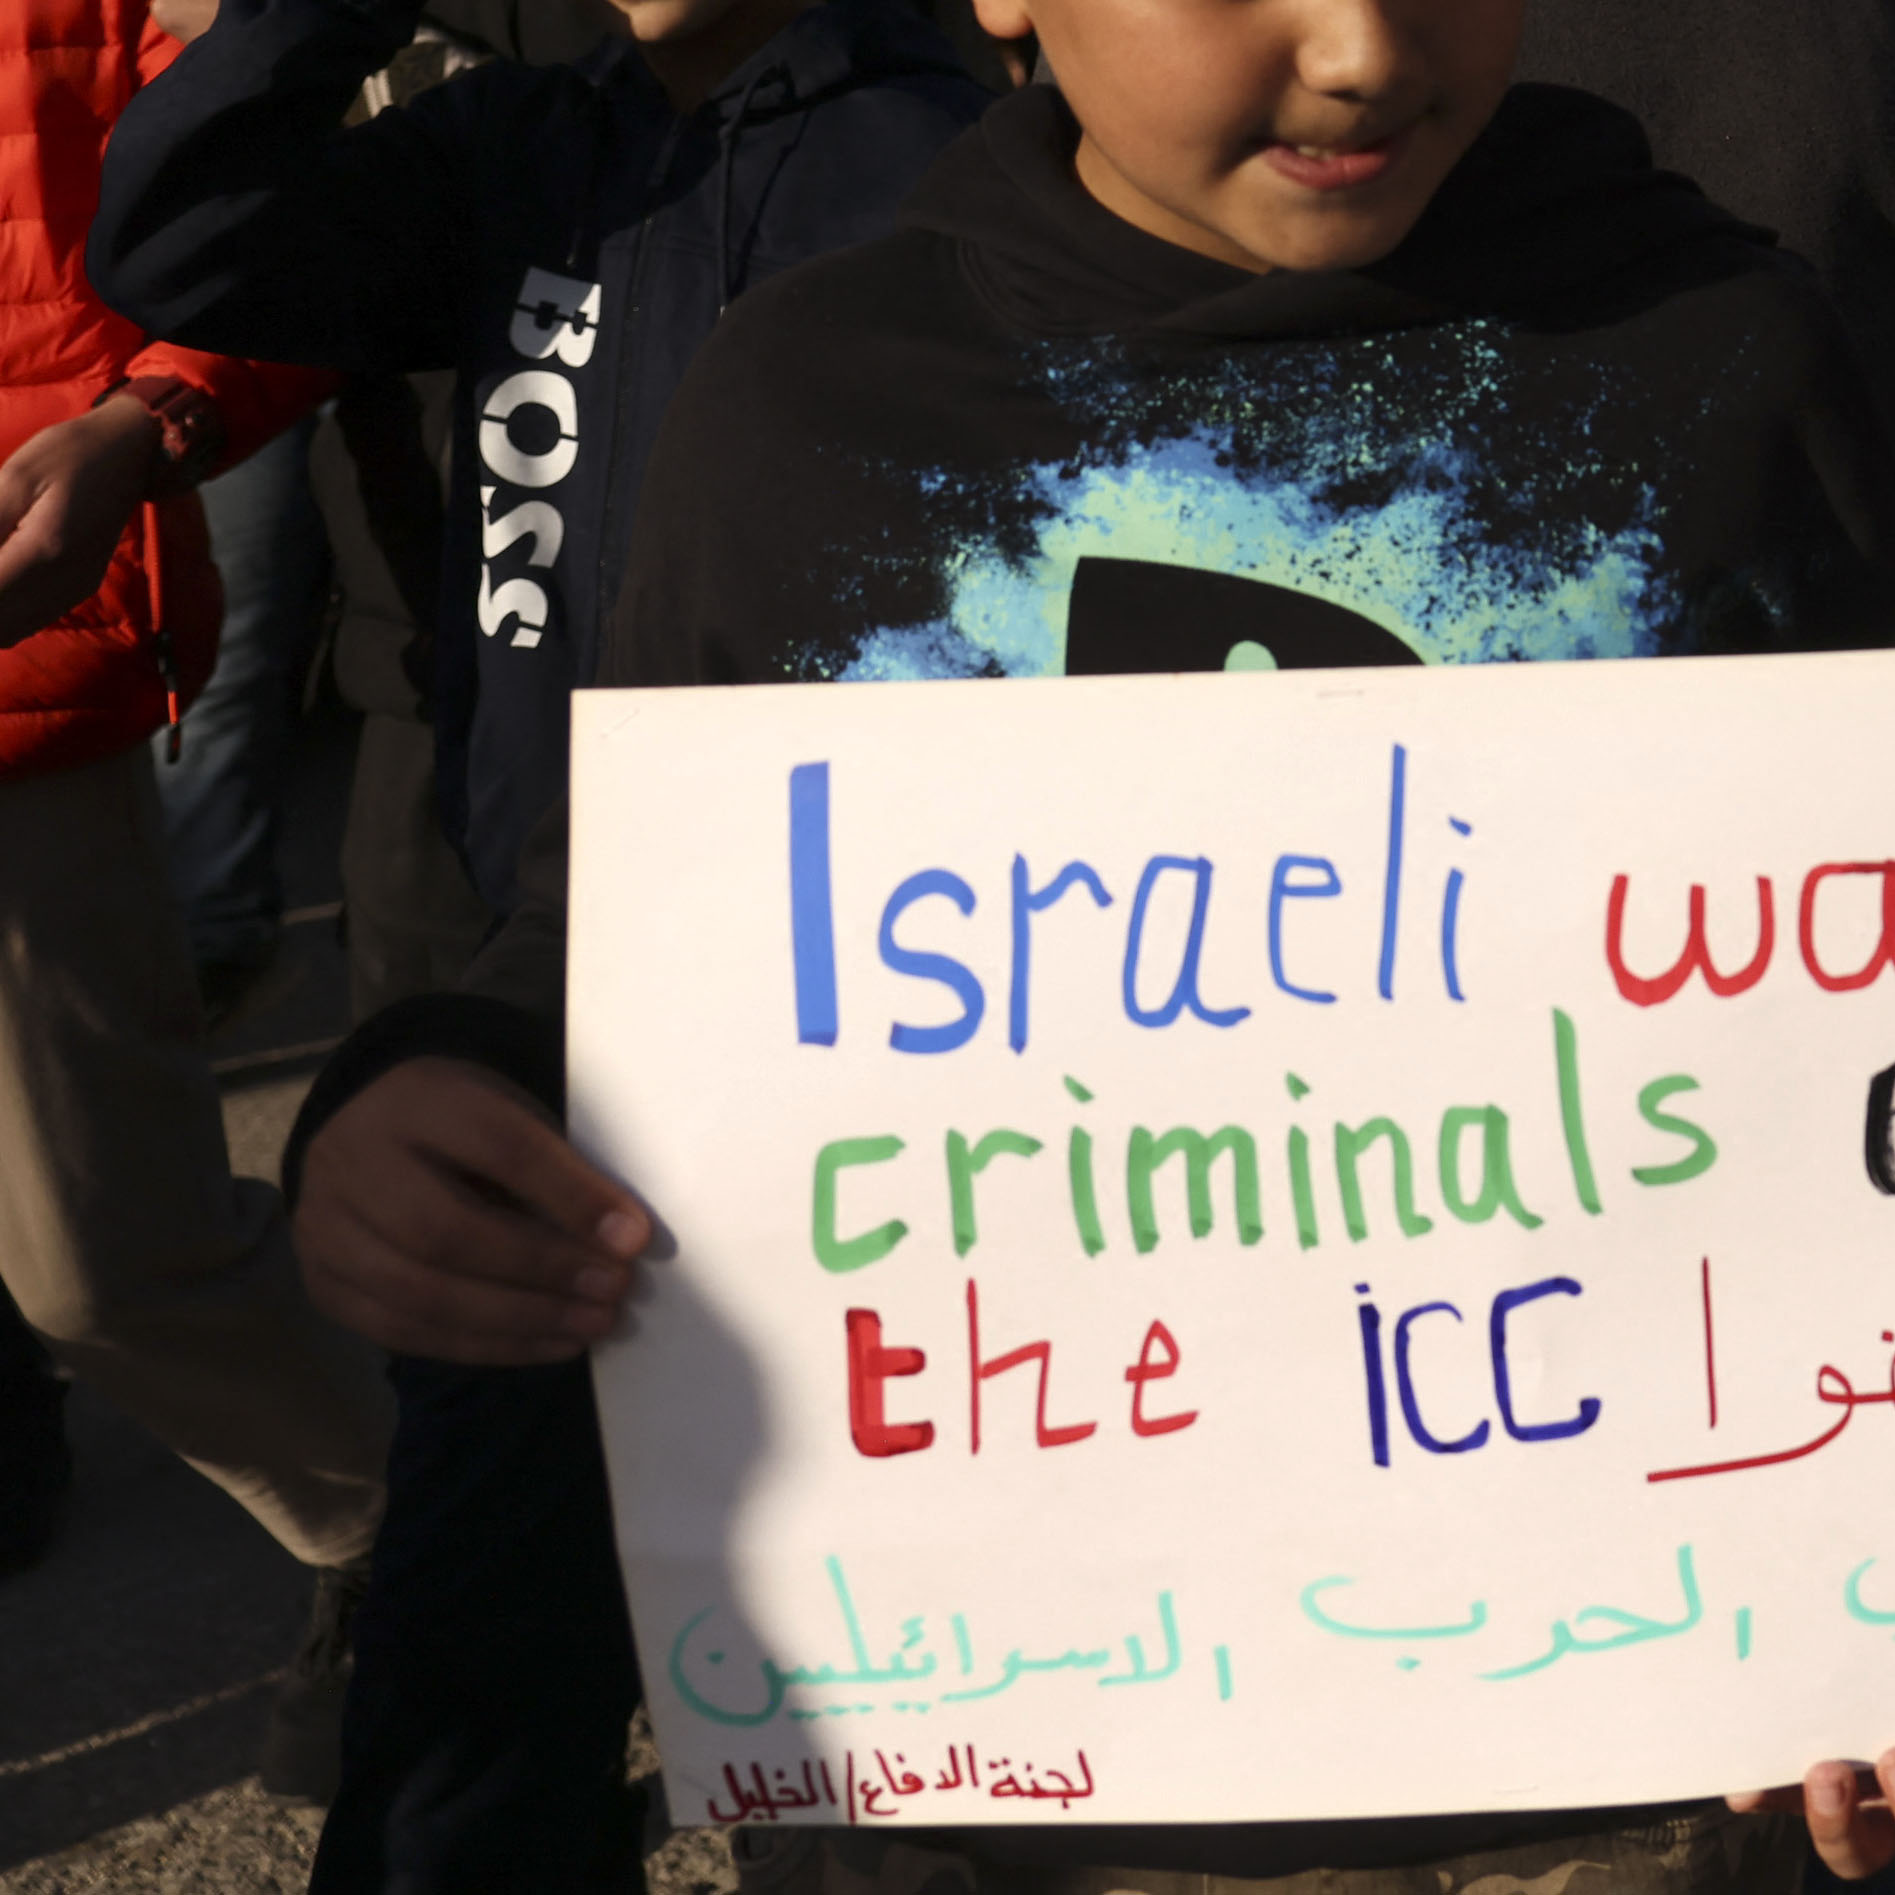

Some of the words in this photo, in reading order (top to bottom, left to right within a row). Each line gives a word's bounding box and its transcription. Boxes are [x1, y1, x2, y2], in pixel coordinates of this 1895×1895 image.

[477, 265, 603, 649] BOSS
[791, 745, 1471, 1053] Israeli
[809, 1008, 1718, 1275] criminals
[844, 1278, 1199, 1459] the
[1299, 1543, 1754, 1681] الحرب
[988, 1749, 1096, 1810] لجنة
